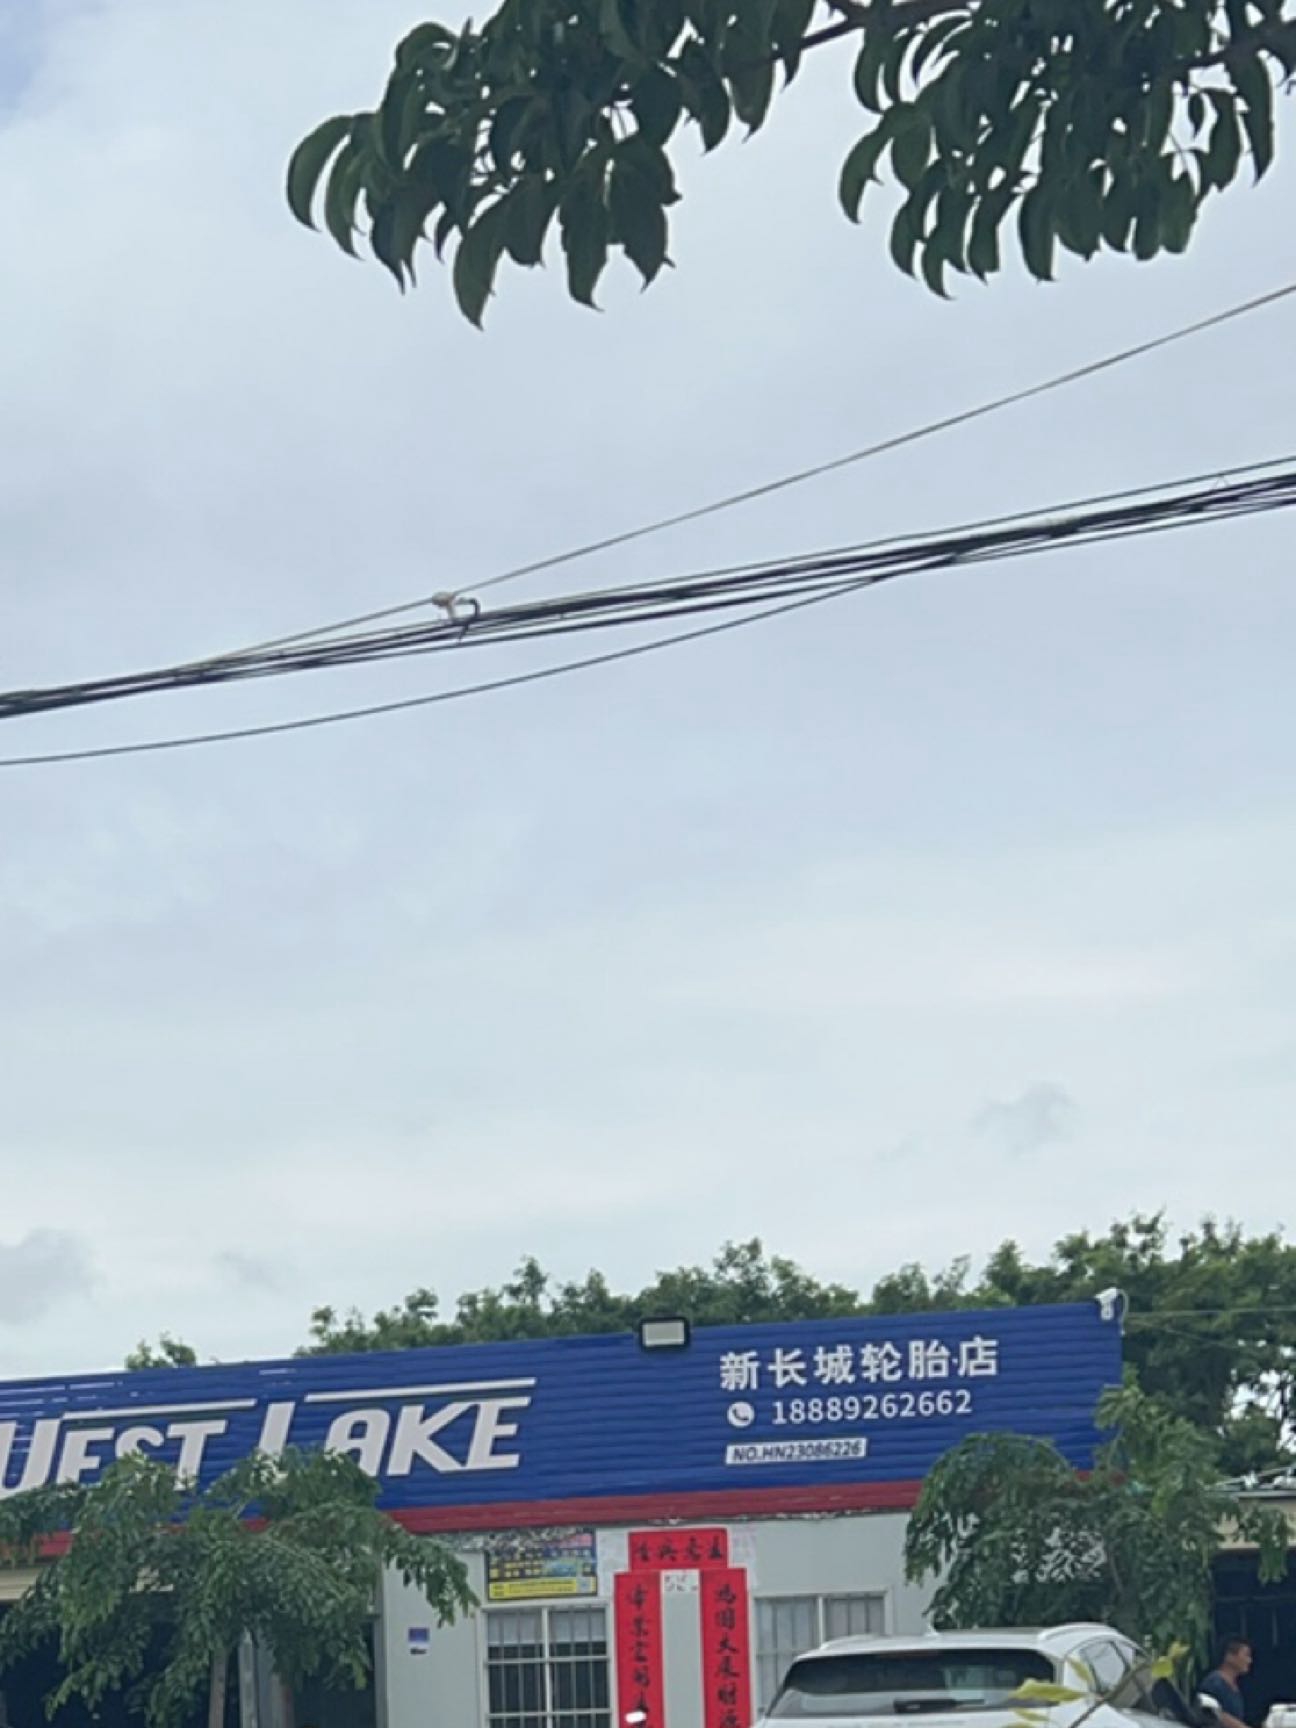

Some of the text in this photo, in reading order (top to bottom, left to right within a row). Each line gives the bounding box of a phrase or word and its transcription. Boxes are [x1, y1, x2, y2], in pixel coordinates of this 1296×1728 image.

[720, 1335, 998, 1391] 新长城轮胎店
[772, 1389, 973, 1425] 18889262662
